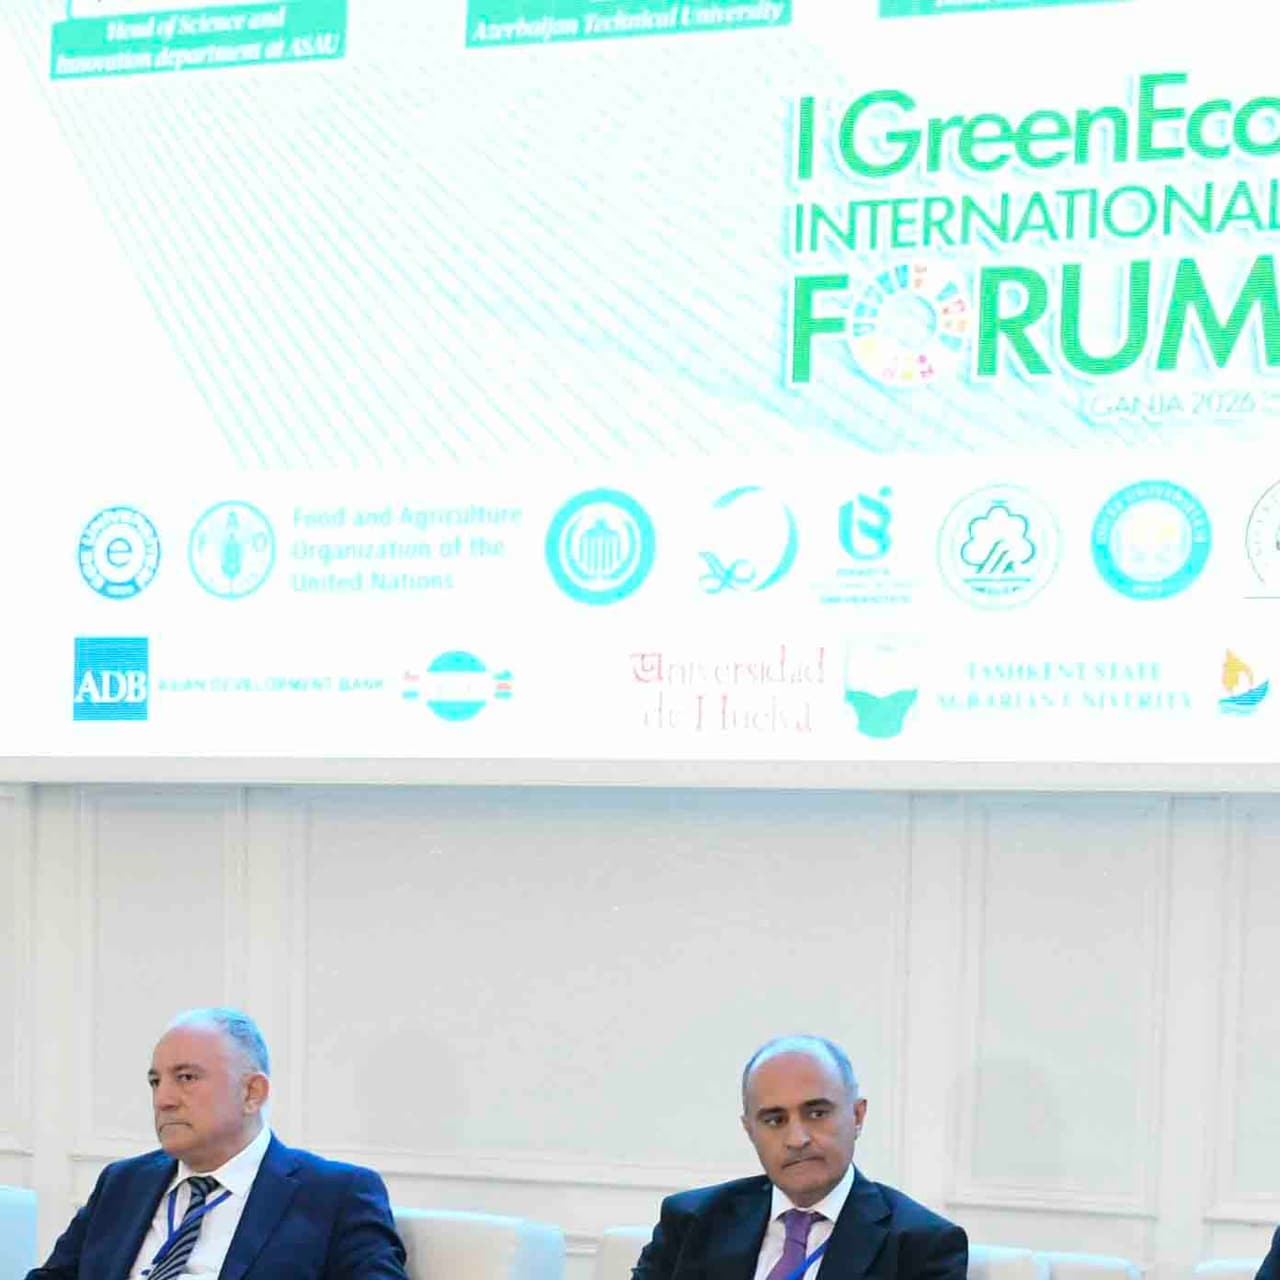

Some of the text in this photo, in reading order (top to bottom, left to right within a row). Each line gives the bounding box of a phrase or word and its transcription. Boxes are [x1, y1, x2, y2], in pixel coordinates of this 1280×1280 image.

[798, 96, 815, 180] I
[293, 503, 524, 532] Food and Agriculture
[289, 534, 506, 567] Organization of the
[290, 569, 456, 595] United Nations
[76, 668, 149, 702] ADB
